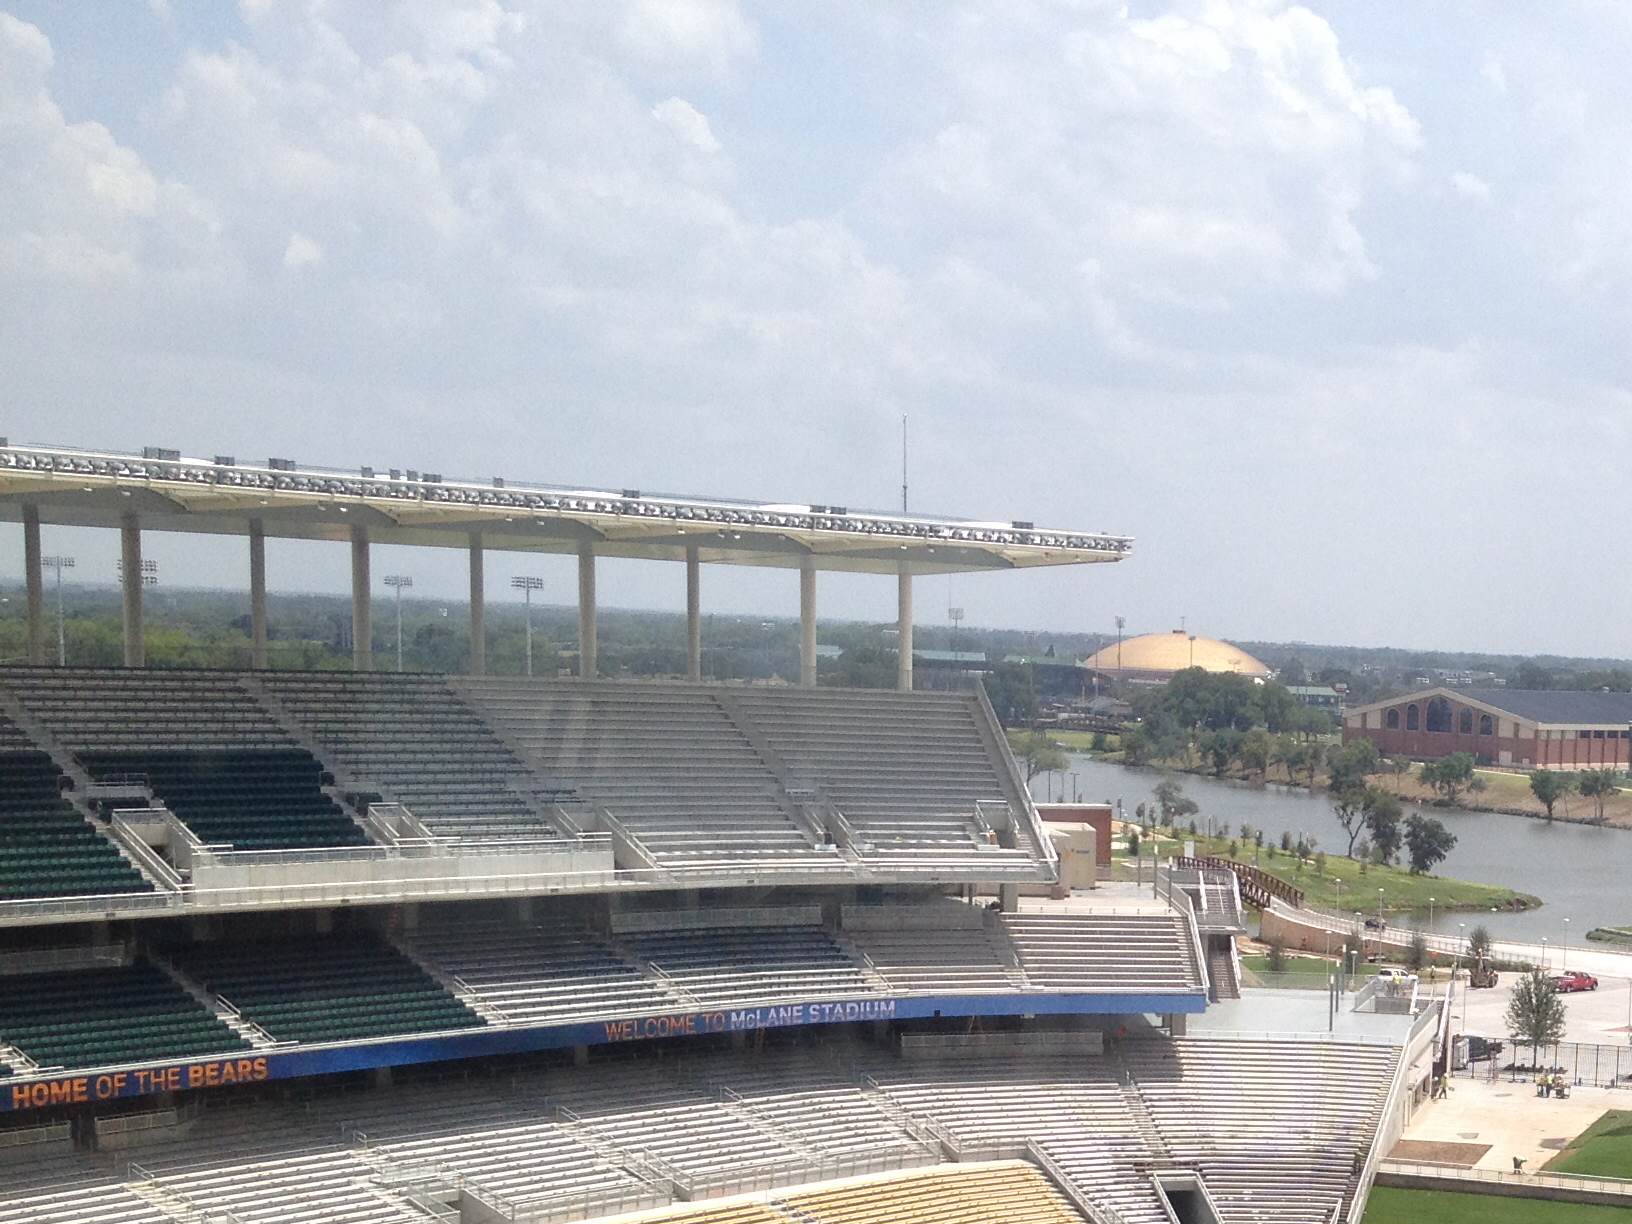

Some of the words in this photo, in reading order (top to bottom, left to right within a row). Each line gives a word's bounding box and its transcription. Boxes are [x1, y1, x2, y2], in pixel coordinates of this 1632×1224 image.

[605, 1015, 696, 1042] WELCOME
[704, 1012, 725, 1031] TO
[731, 1005, 803, 1031] McLANE
[810, 999, 896, 1024] STADIUM
[12, 1078, 88, 1109] HOME
[96, 1073, 127, 1099] OF
[135, 1068, 181, 1093] THE
[188, 1057, 268, 1088] BEARS
